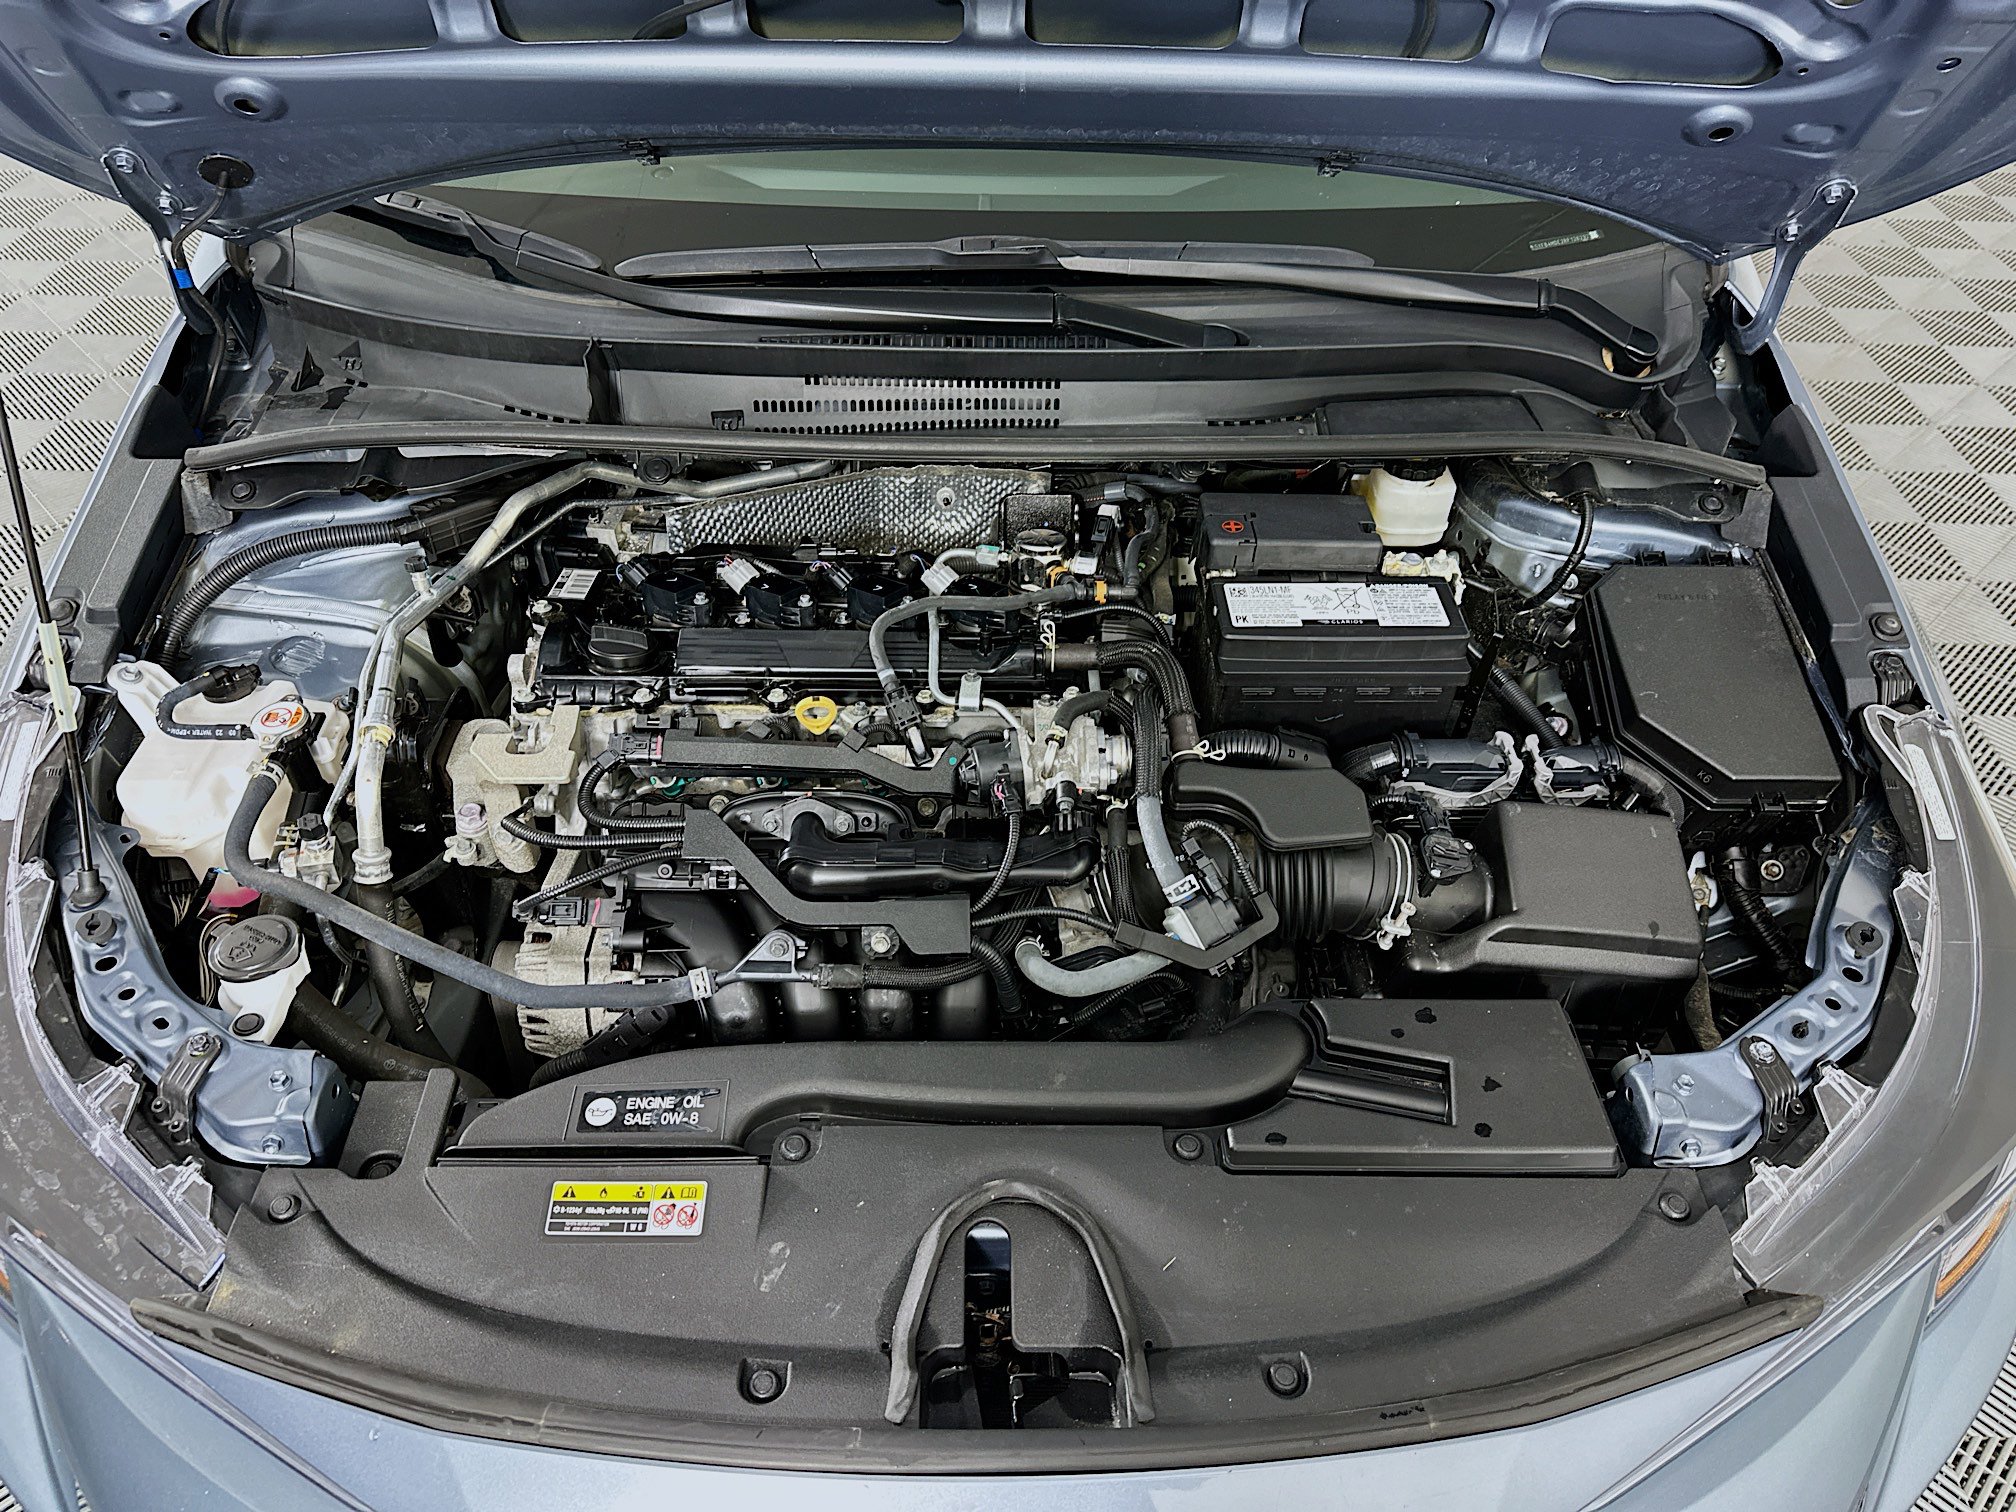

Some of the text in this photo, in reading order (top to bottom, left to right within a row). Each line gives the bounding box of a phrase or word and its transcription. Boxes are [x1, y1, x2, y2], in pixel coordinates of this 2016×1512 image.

[1235, 615, 1249, 624] PK
[191, 729, 213, 737] WATER
[1696, 769, 1713, 783] K6
[626, 1096, 705, 1110] ENGINE OIL
[623, 1111, 699, 1126] SAE 0W-8
